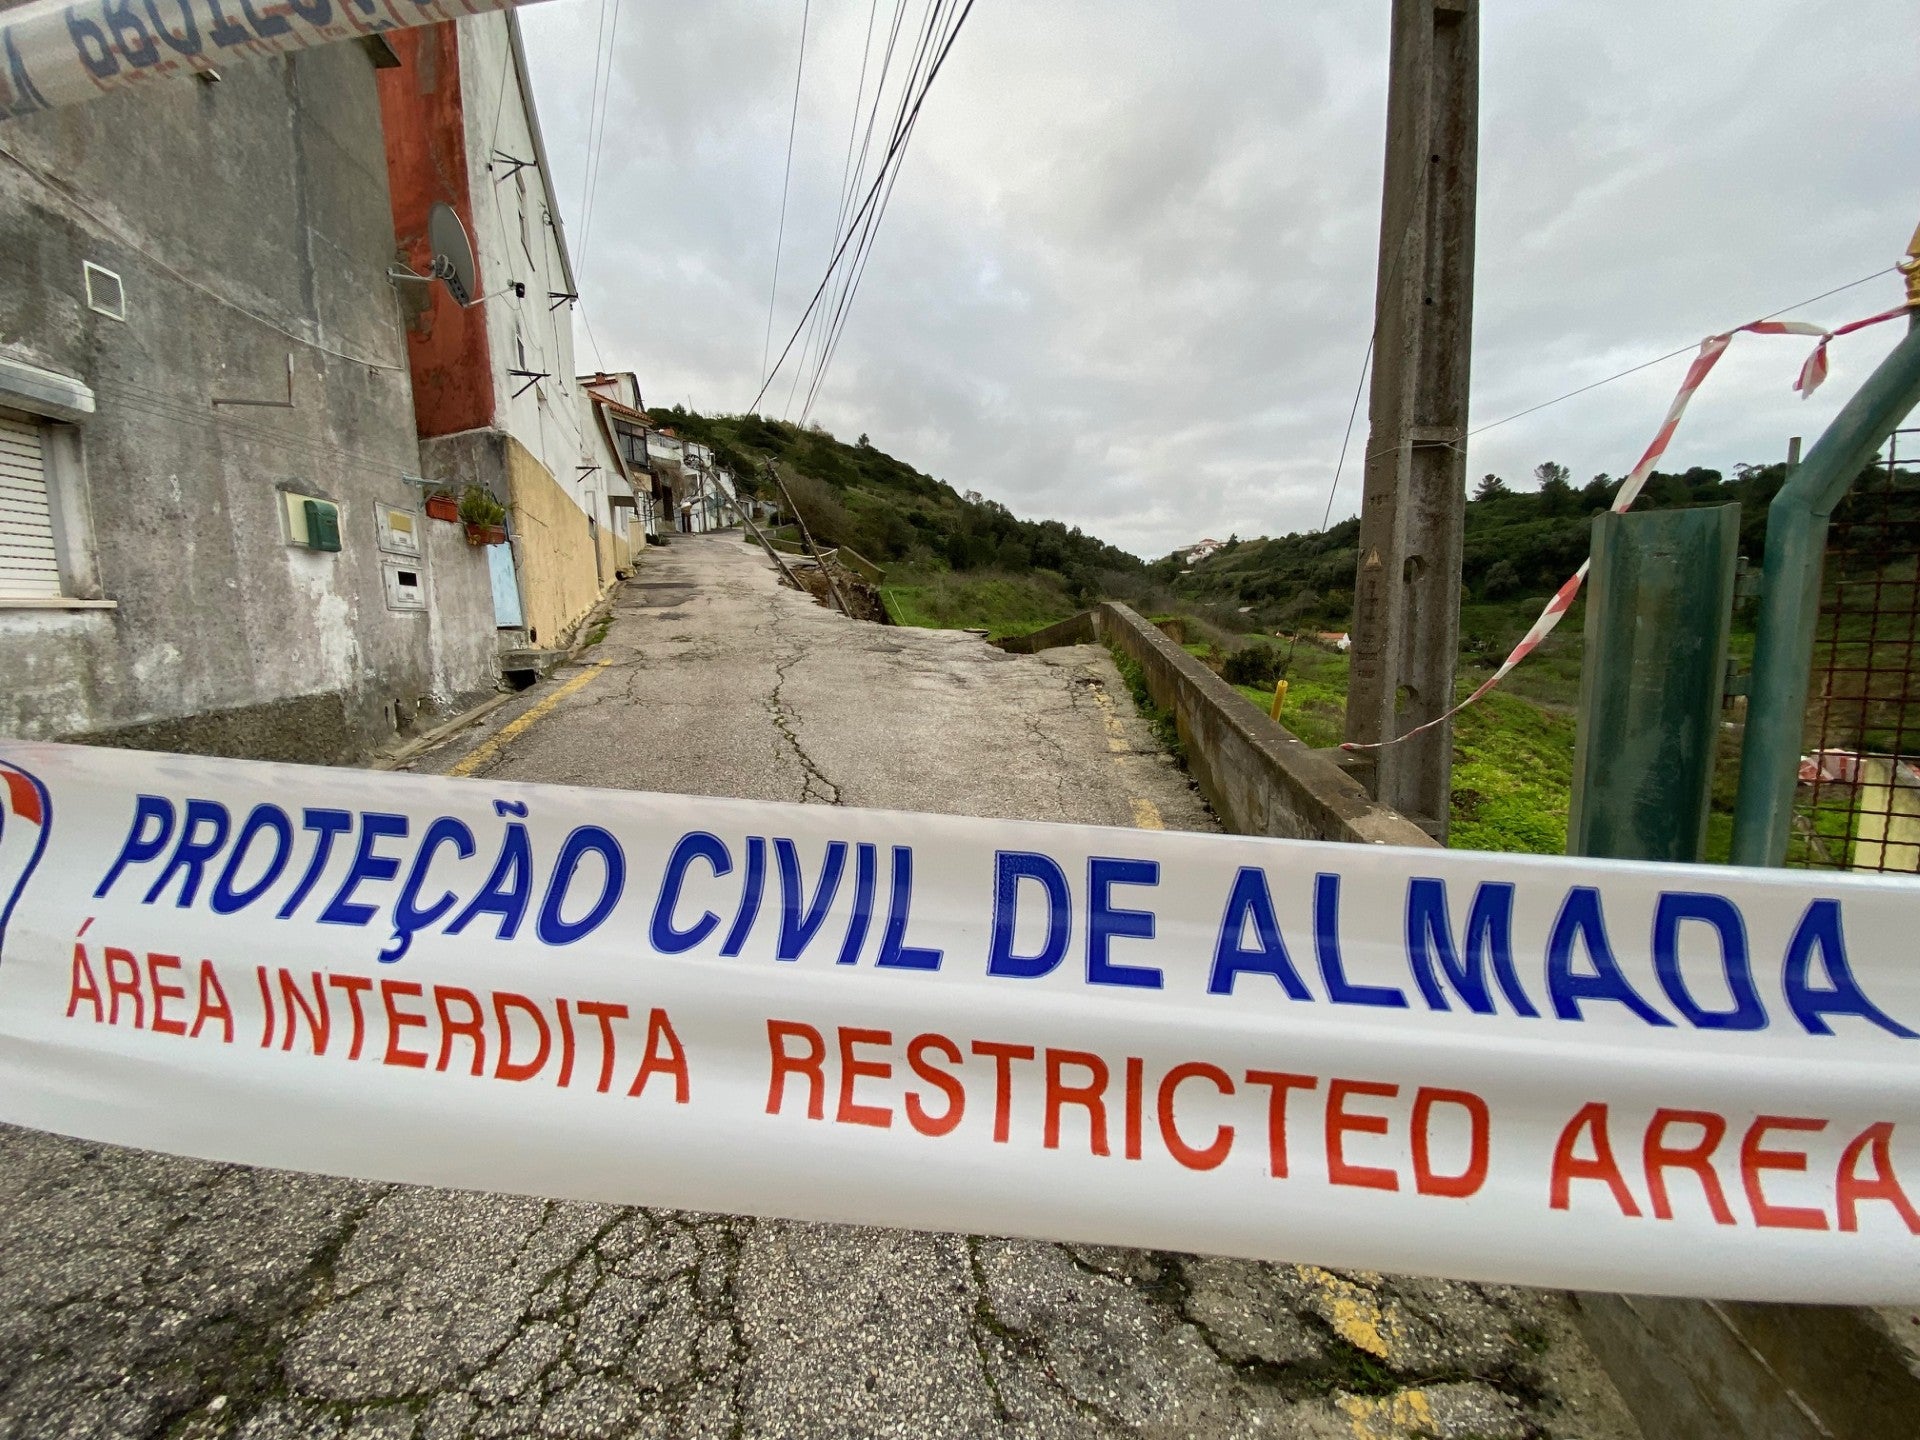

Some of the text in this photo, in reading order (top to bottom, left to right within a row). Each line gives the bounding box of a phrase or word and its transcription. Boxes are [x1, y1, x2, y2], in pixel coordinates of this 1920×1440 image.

[93, 794, 1920, 1039] PROTEÇÃO CIVIL DE ALMADA
[66, 917, 1920, 1236] ÁREA INTERDITA RESTRICTED AREA
